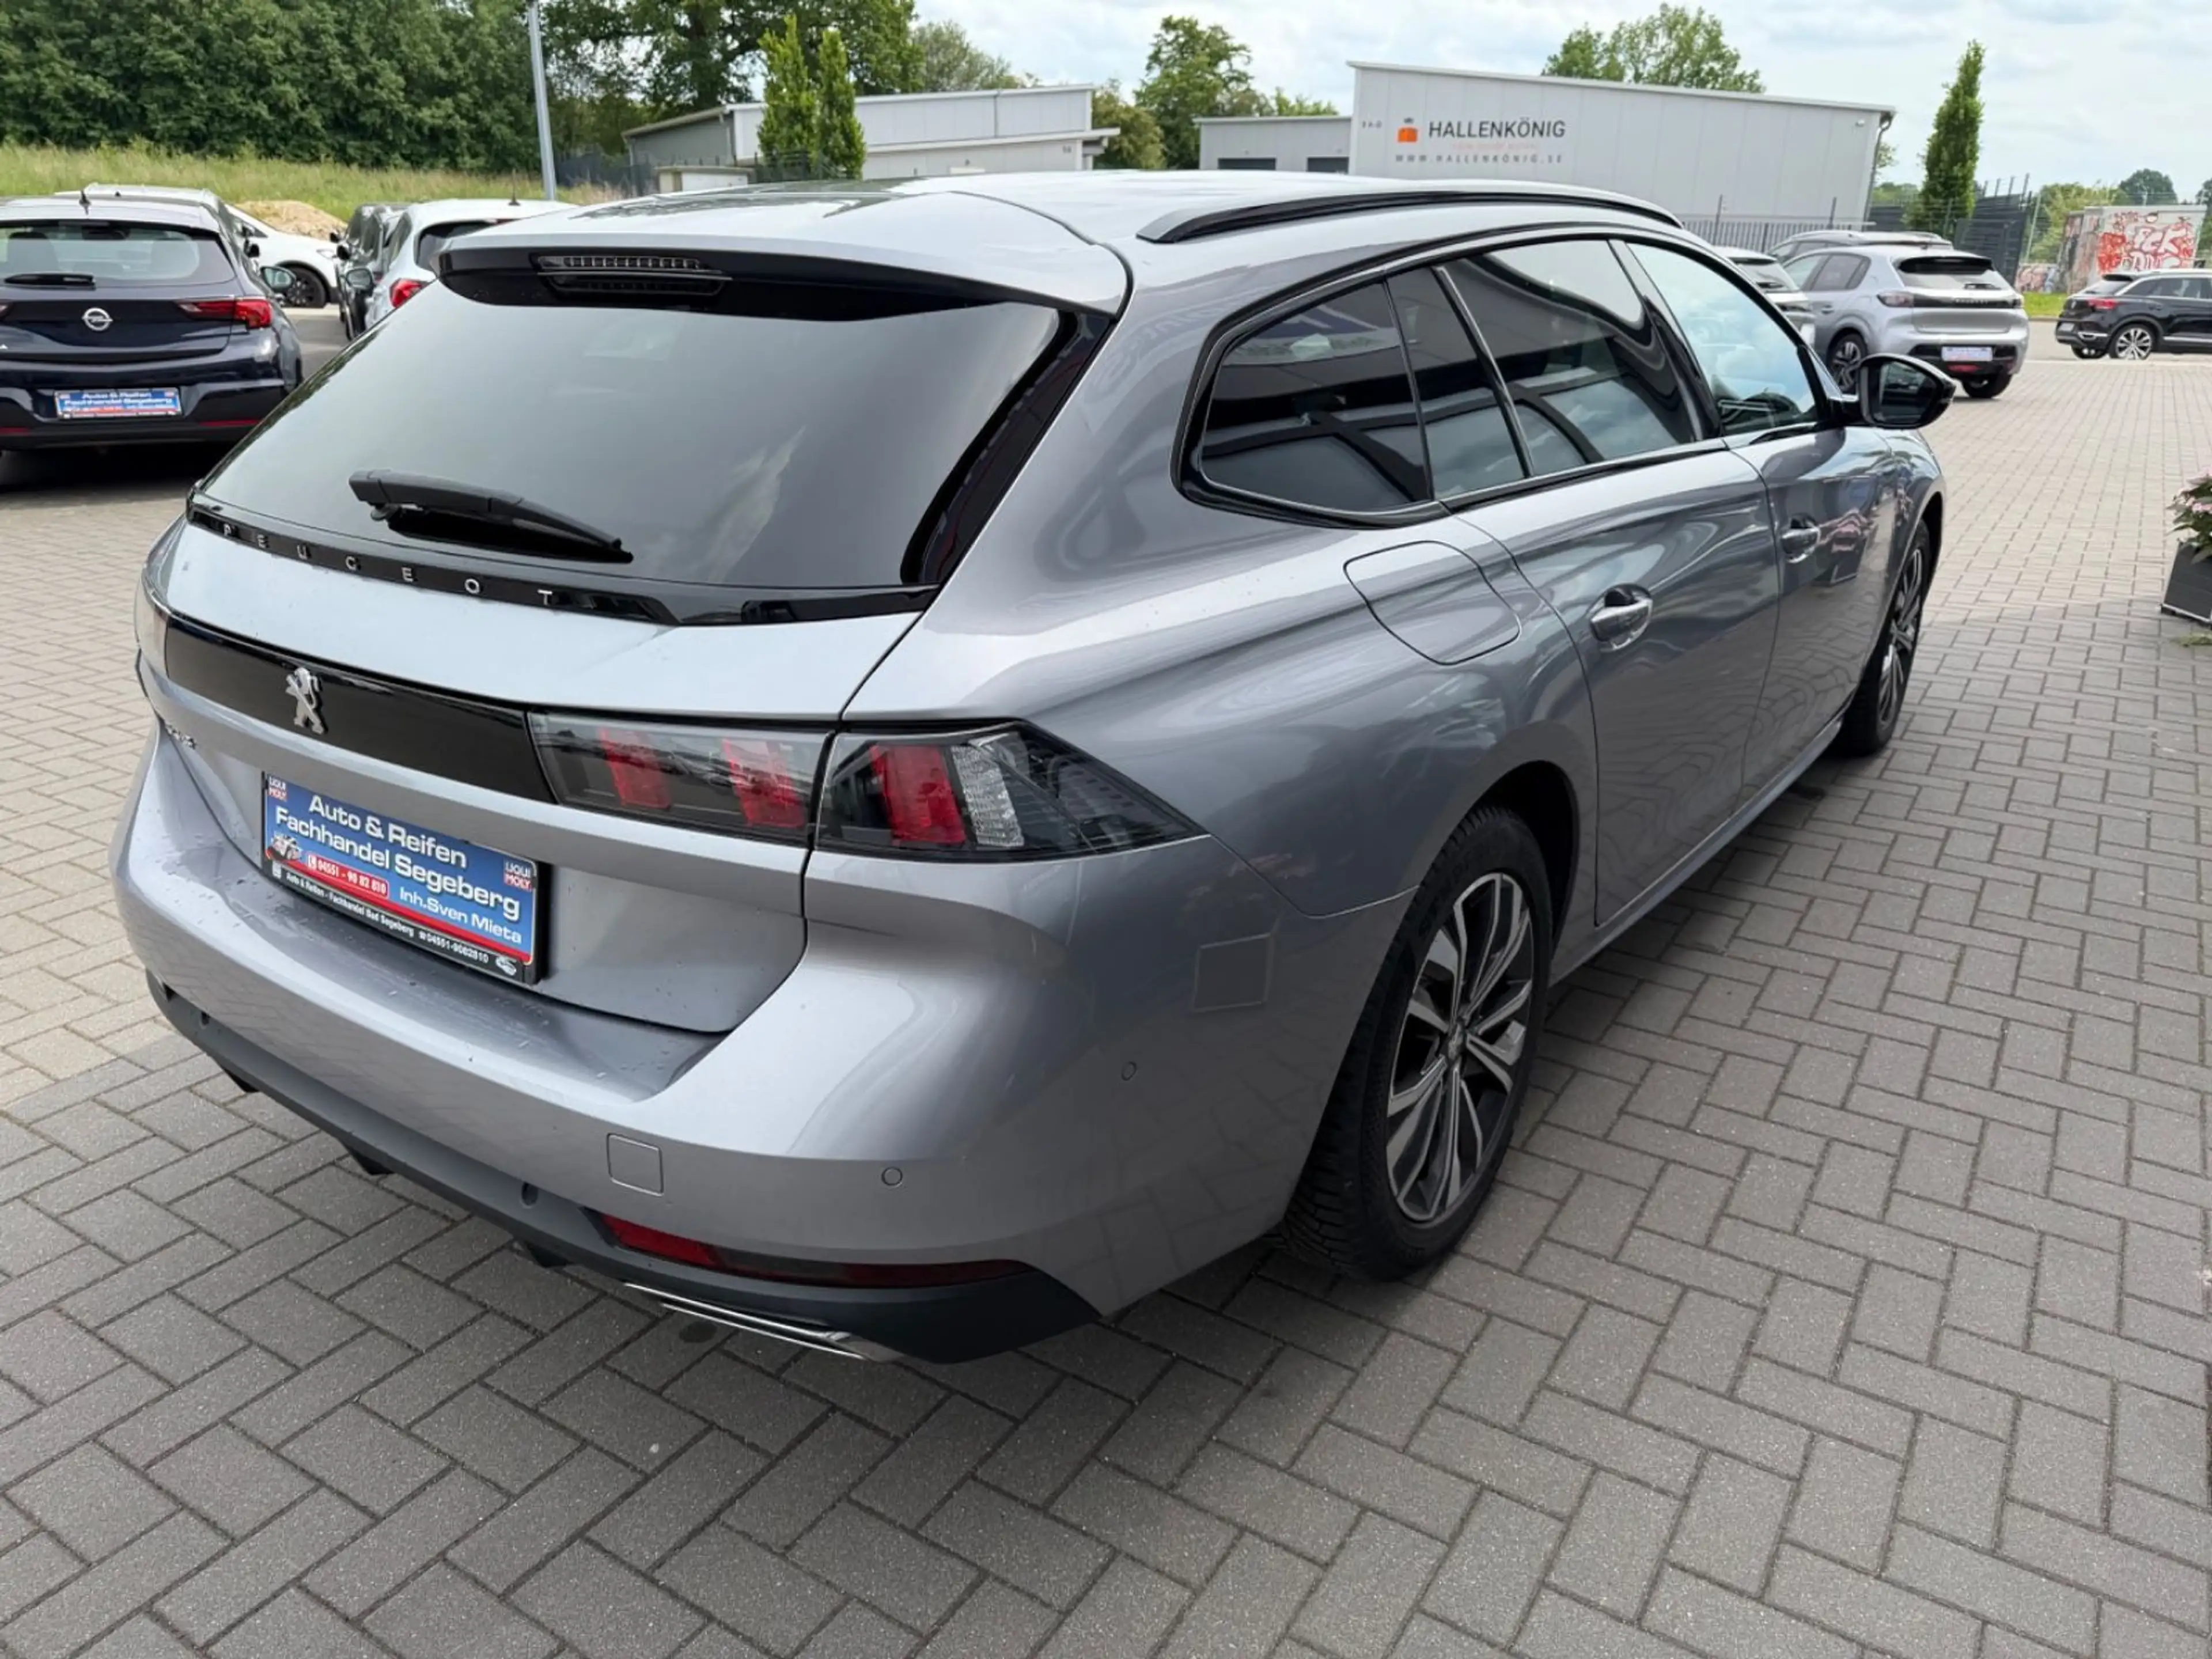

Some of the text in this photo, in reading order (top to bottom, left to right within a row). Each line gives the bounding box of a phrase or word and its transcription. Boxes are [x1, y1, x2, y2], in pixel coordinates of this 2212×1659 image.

[1429, 117, 1566, 138] HALLENKÖNIG
[224, 523, 552, 605] PEUGEOT
[276, 805, 519, 921] Fachhandel Segeberg
[309, 794, 467, 868] Auto & Reifen
[400, 886, 522, 944] Inh.Sven Mieta
